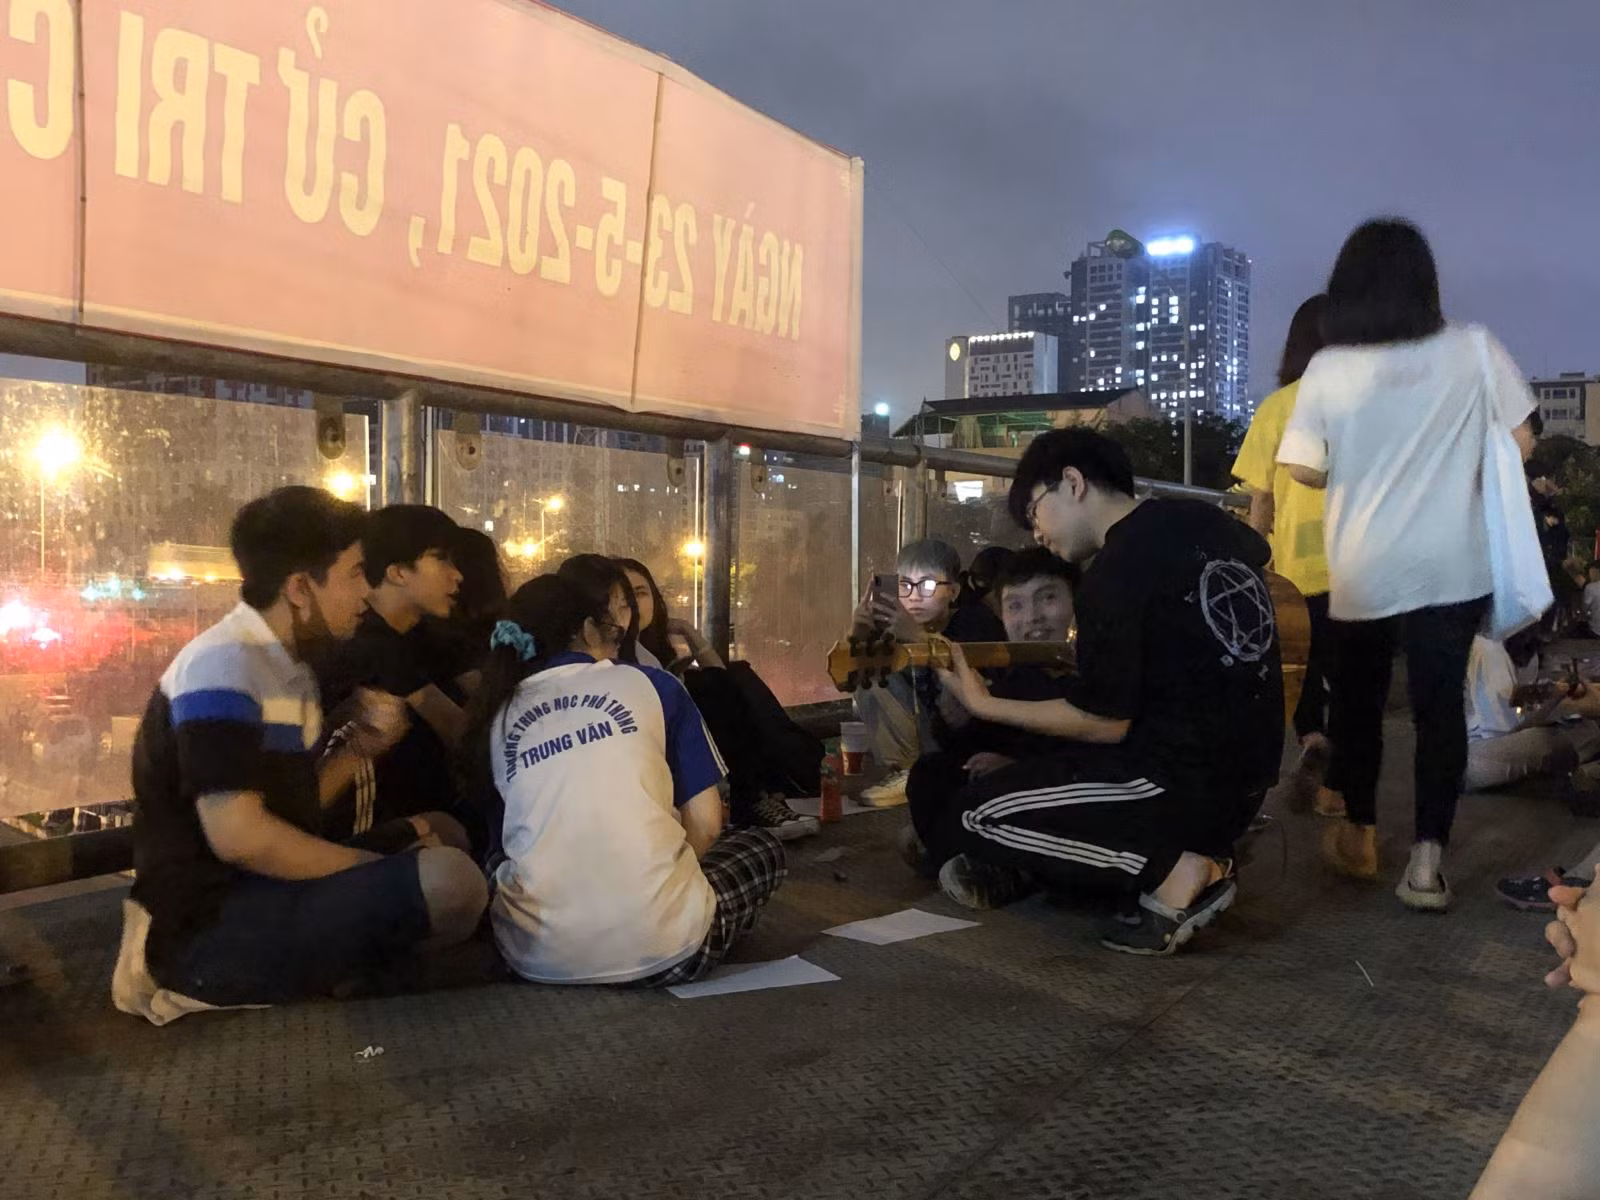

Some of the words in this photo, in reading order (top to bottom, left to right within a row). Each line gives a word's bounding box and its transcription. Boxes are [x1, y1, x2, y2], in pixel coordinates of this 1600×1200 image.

[513, 702, 551, 732] TRUNG
[554, 694, 578, 711] HỌC
[520, 733, 573, 769] TRUNG
[576, 721, 614, 745] VĂN
